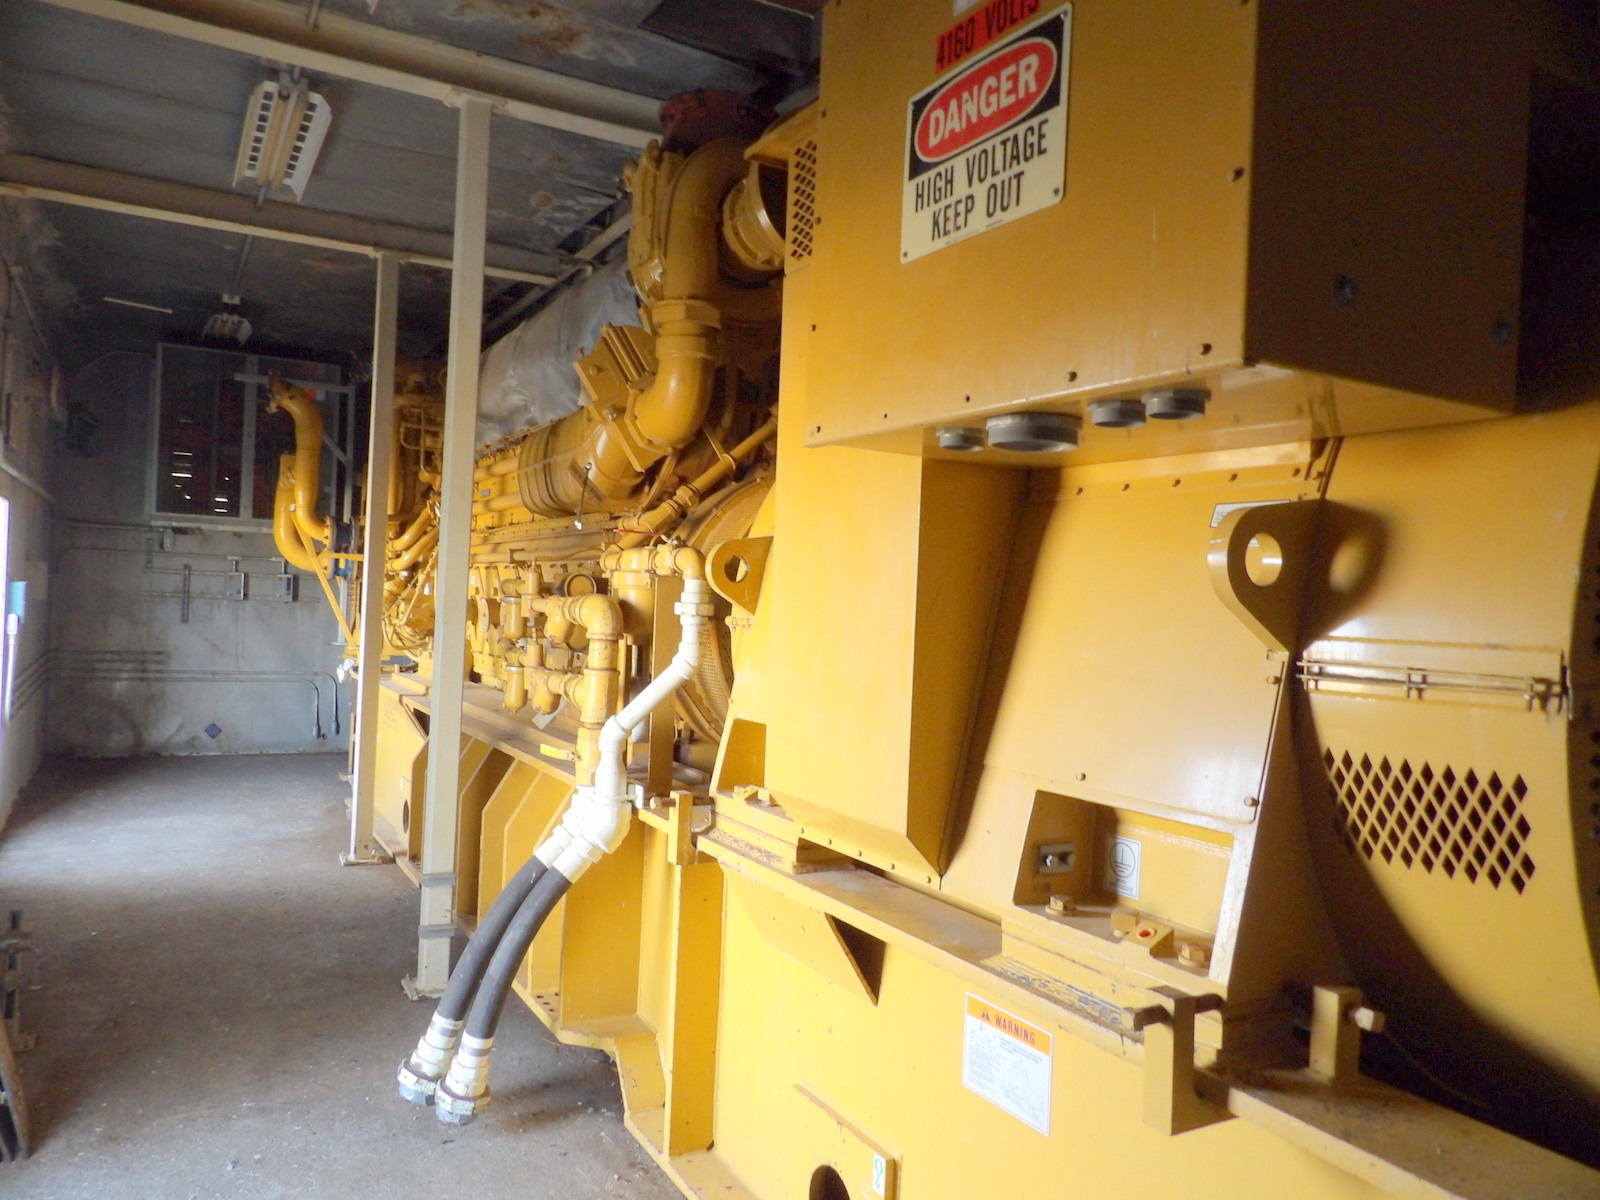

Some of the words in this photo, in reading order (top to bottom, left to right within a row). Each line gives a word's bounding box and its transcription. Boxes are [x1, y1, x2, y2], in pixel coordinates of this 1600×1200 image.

[936, 17, 975, 68] 4160
[929, 54, 1039, 148] DANGER
[915, 165, 954, 213] HIGH
[966, 118, 1048, 188] VOLTAGE
[931, 194, 975, 242] KEEP
[986, 171, 1025, 219] OUT
[995, 1014, 1035, 1045] WARNING
